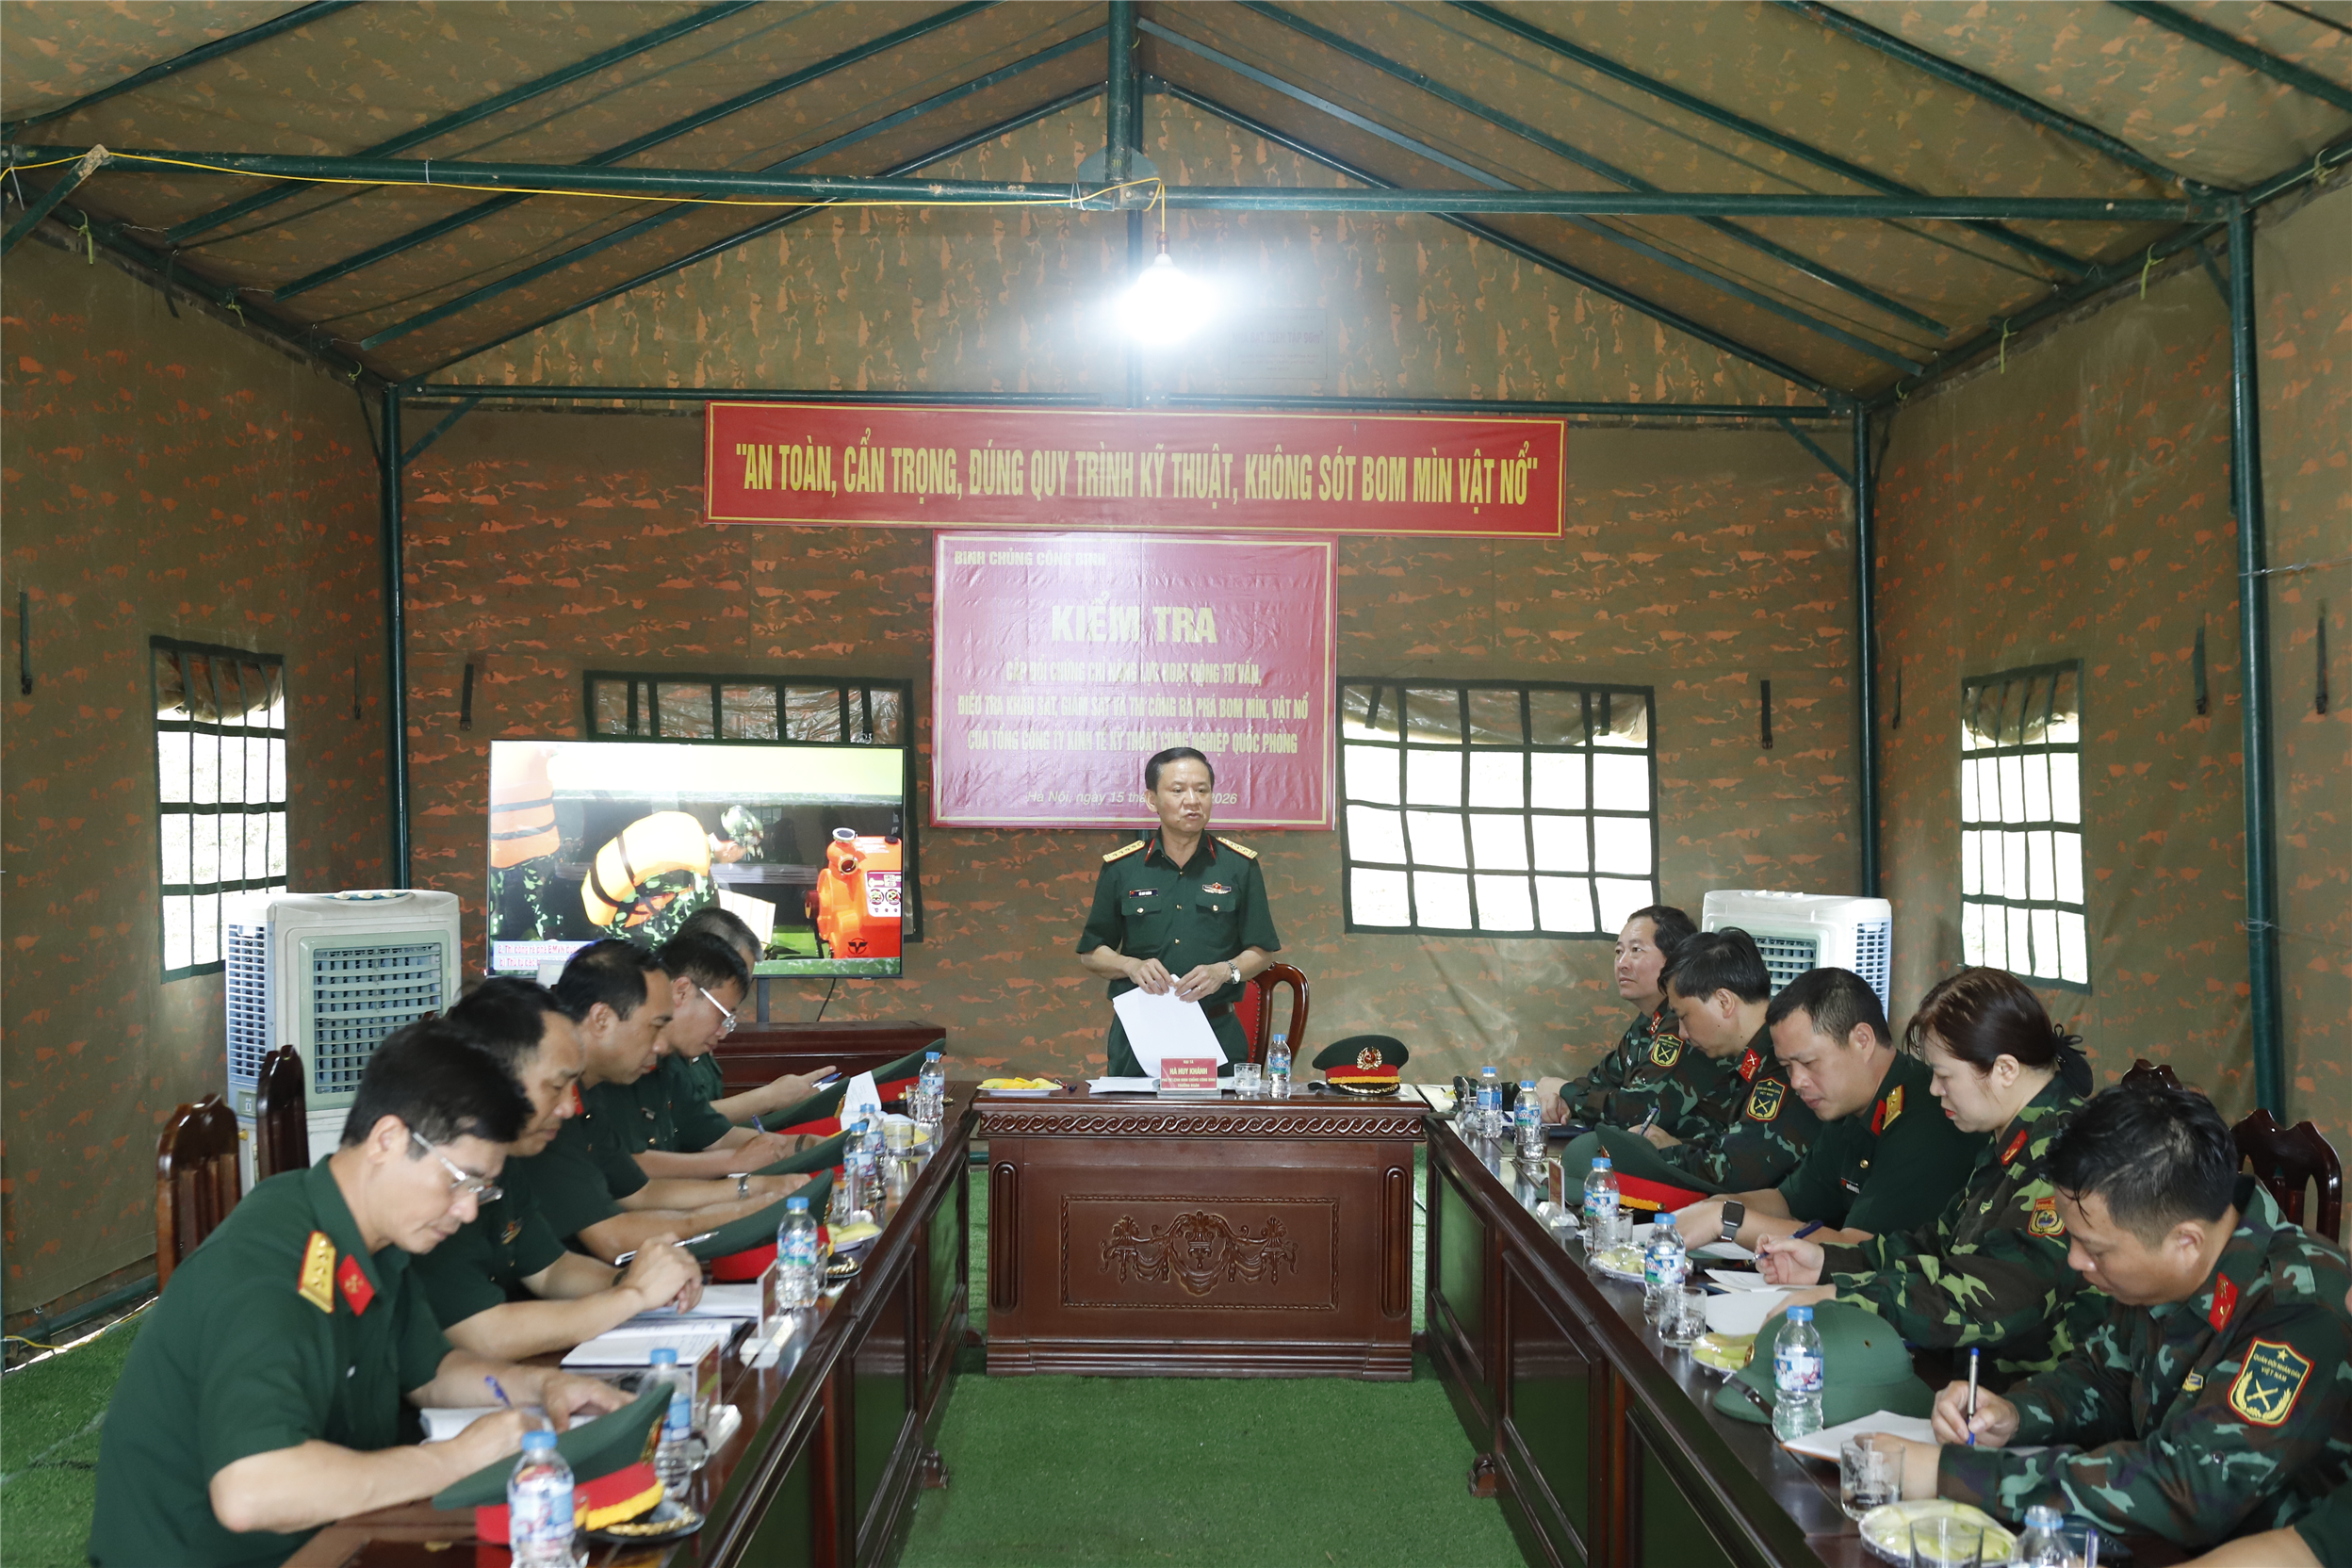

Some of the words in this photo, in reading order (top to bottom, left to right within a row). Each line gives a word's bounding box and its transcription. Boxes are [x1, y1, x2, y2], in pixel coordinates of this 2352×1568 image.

[779, 435, 837, 498] TOÀN,
[844, 427, 885, 493] CẨN
[891, 447, 962, 504] TRỌNG,
[969, 439, 1023, 496] ĐÚNG
[1031, 449, 1069, 501] QUY
[1075, 441, 1134, 498] TRÌNH
[1140, 443, 1166, 498] KỸ
[1171, 443, 1238, 509] THUẬT,
[1246, 444, 1312, 500] KHÔNG
[1319, 446, 1356, 501] SÓT
[1362, 455, 1406, 502] BOM
[1413, 447, 1451, 502] MÌN
[1459, 448, 1494, 514] VẬT
[954, 550, 986, 565] BINH
[989, 547, 1033, 565] CHỦNG
[1037, 549, 1071, 565] CÔNG
[1075, 552, 1106, 566] BINH
[1052, 591, 1141, 643] KIỂM
[1152, 606, 1217, 644] TRA
[1162, 662, 1189, 686] HOẠT
[1191, 658, 1220, 687] ĐỘNG
[1222, 662, 1236, 683] TƯ
[1237, 657, 1262, 686] VẤN,
[985, 695, 1004, 715] TRA
[1061, 692, 1088, 716] GIÁM
[1091, 693, 1112, 716] SÁT
[1113, 693, 1127, 716] VÀ
[1129, 696, 1146, 717] THI
[1148, 693, 1176, 717] CÔNG
[1179, 694, 1193, 717] RÀ
[1196, 694, 1217, 718] PHÁ
[1219, 698, 1243, 718] BOM
[1246, 694, 1269, 721] MÌN,
[1272, 694, 1292, 723] VẬT
[1294, 692, 1309, 719] NỔ
[968, 724, 988, 750] CỦA
[991, 722, 1019, 750] TỔNG
[1053, 730, 1064, 750] TY
[1067, 730, 1092, 751] KINH
[1160, 727, 1189, 750] CÔNG
[1191, 728, 1229, 757] NGHIỆP
[1232, 727, 1260, 755] QUỐC
[1262, 729, 1298, 754] PHÒNG
[1028, 792, 1044, 803] Hà
[1048, 791, 1071, 805] Nội,
[1076, 792, 1105, 806] ngày
[1110, 792, 1124, 803] 15
[1128, 791, 1146, 803] thá
